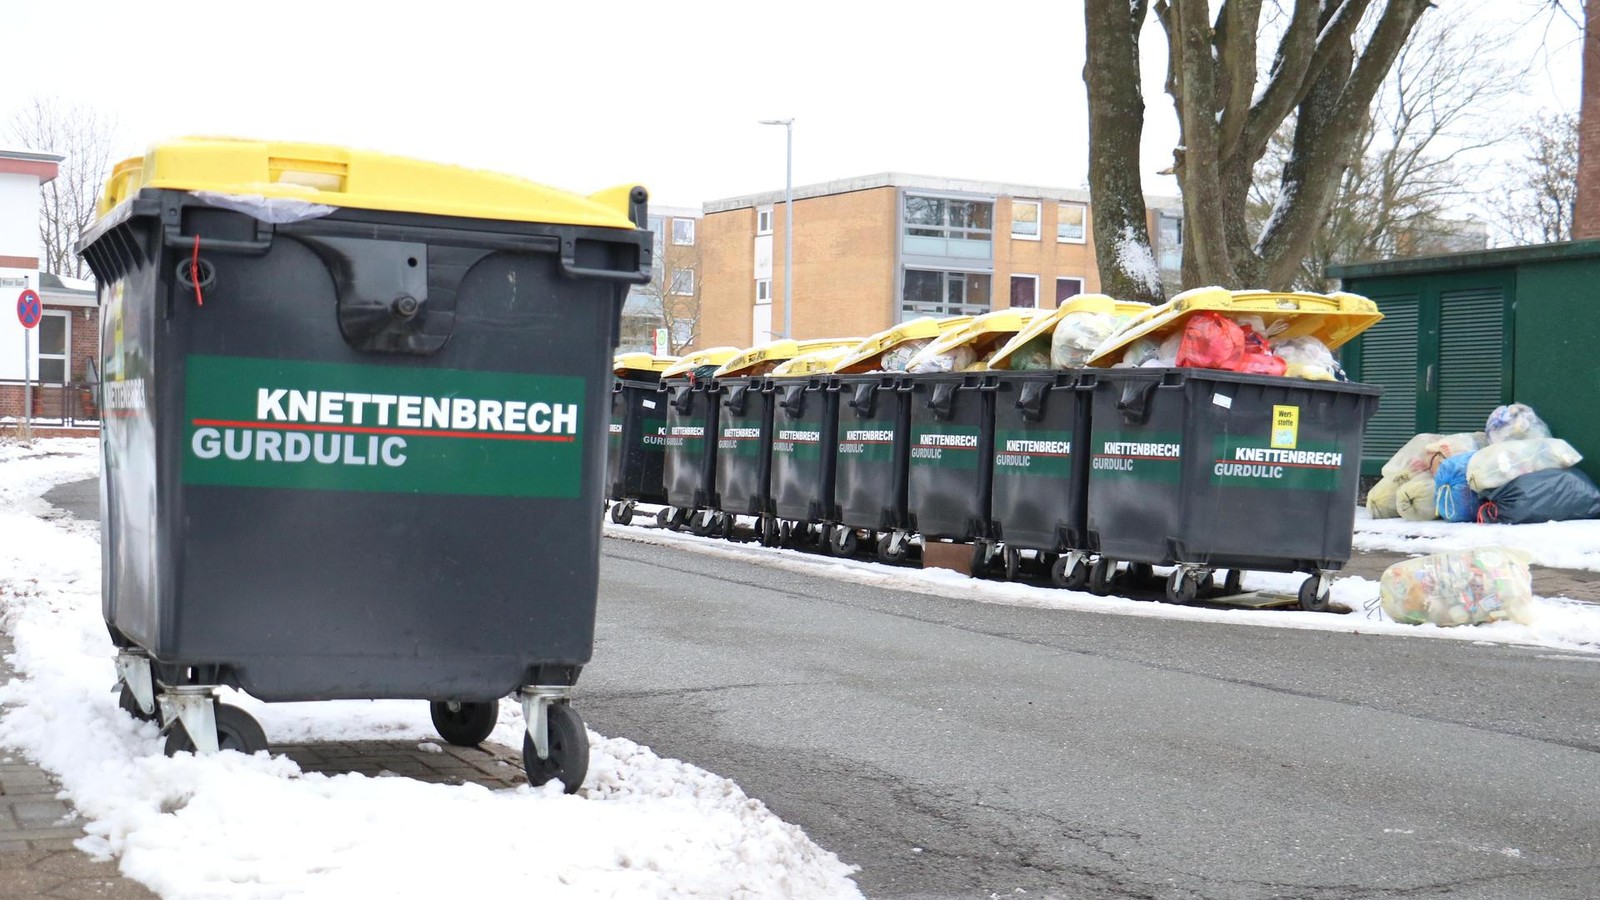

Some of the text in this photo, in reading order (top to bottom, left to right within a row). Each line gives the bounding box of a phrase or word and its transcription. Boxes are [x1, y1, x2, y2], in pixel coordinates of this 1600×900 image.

[257, 388, 578, 434] KNETTENBRECH
[847, 430, 894, 441] KNETTENBRECH
[920, 434, 978, 446] KNETTENBRECH
[191, 428, 408, 467] GURDULIC
[911, 447, 942, 459] GURDULIC
[1006, 440, 1070, 454] KNETTENBRECH
[1104, 442, 1180, 457] KNETTENBRECH
[996, 454, 1031, 467] GURDULIC
[1235, 447, 1342, 466] KNETTENBRECH
[1092, 457, 1134, 471] GURDULIC
[1214, 463, 1283, 479] GURDULIC
